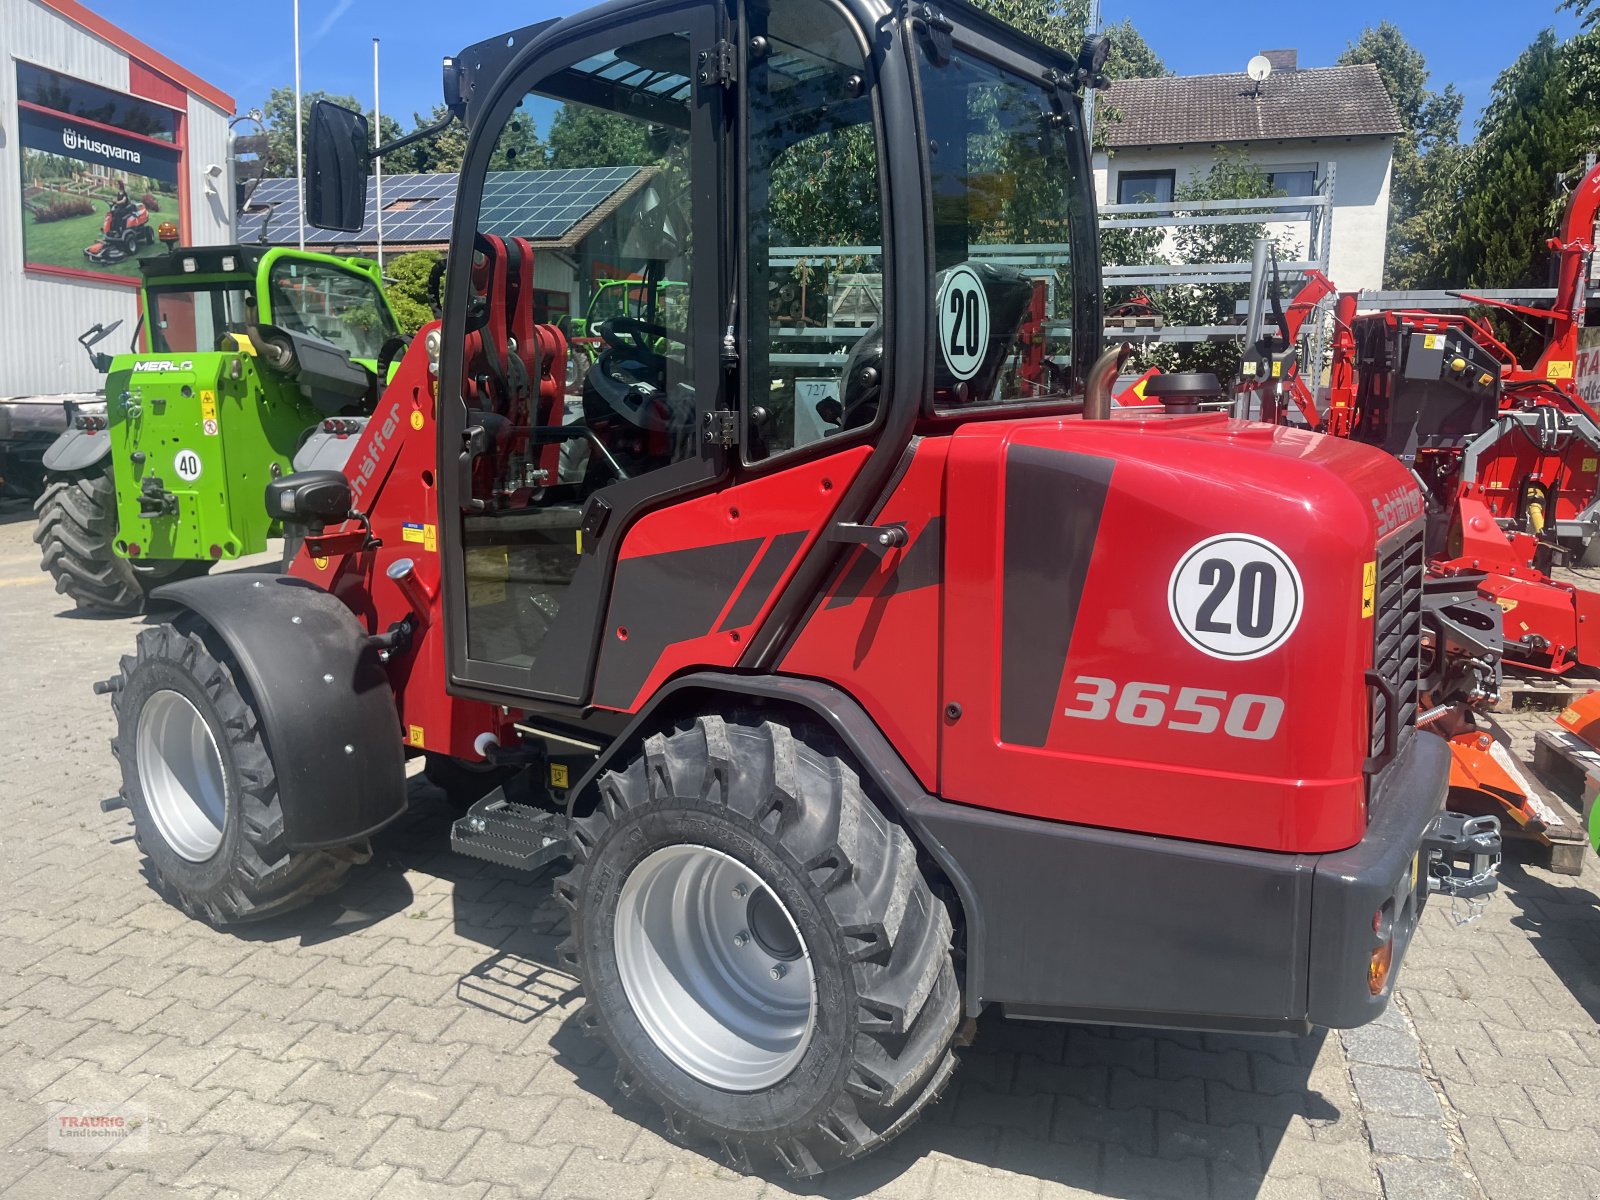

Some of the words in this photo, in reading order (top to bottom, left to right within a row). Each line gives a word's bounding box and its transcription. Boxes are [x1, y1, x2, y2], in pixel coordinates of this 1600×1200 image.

[77, 133, 141, 164] Husqvarna
[950, 288, 979, 357] 20
[805, 384, 827, 397] 727
[179, 456, 198, 476] 40
[338, 402, 400, 533] häffer
[1371, 484, 1420, 537] Schäffer
[1194, 557, 1278, 639] 20
[1063, 674, 1286, 741] 3650
